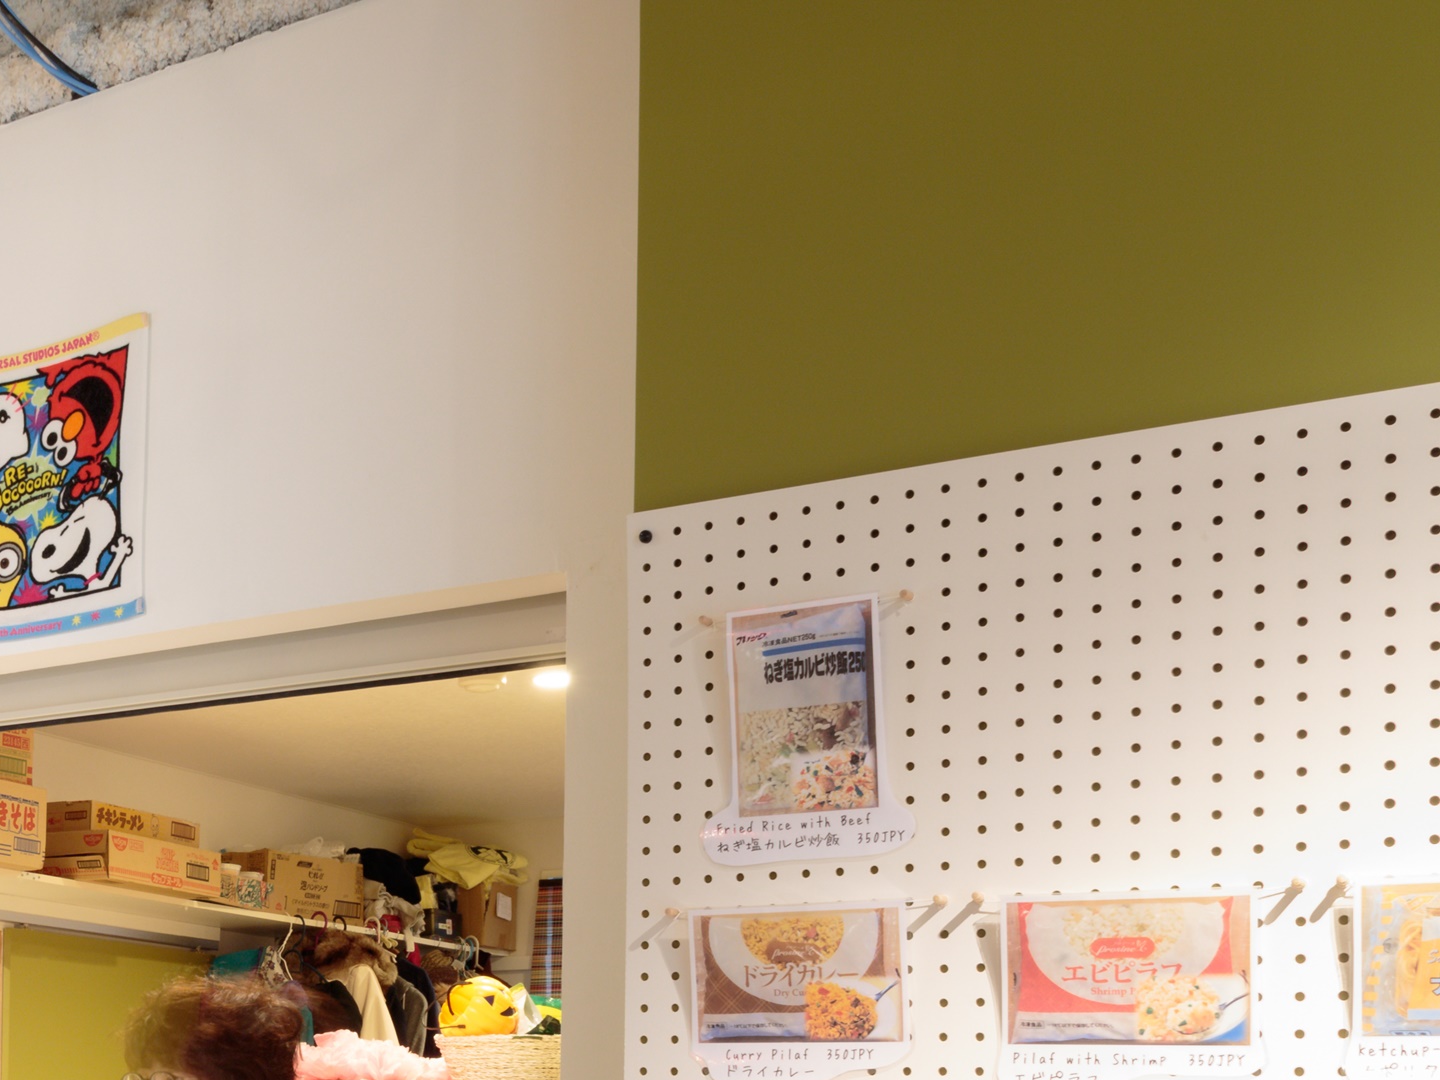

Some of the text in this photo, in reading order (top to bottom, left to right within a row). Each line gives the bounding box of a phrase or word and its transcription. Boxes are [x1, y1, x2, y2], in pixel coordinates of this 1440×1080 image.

[22, 345, 61, 364] STUDIOS
[4, 462, 34, 487] RE-
[9, 620, 63, 636] Anniversary
[96, 807, 144, 831] チキンラーメン
[717, 812, 872, 835] Fried Rice with Beef
[717, 830, 906, 854] ねぎ塩カルビ炒飯 350JPY
[743, 964, 860, 988] ドライカレー
[1061, 960, 1183, 984] エビピラフ
[773, 988, 789, 999] Dry
[1090, 987, 1127, 997] Shrimp
[725, 1048, 875, 1062] Curry Pilaf 350JPY
[1012, 1052, 1247, 1067] Pilaf with Shrimp 350JPY
[726, 1065, 815, 1078] ドライカレー
